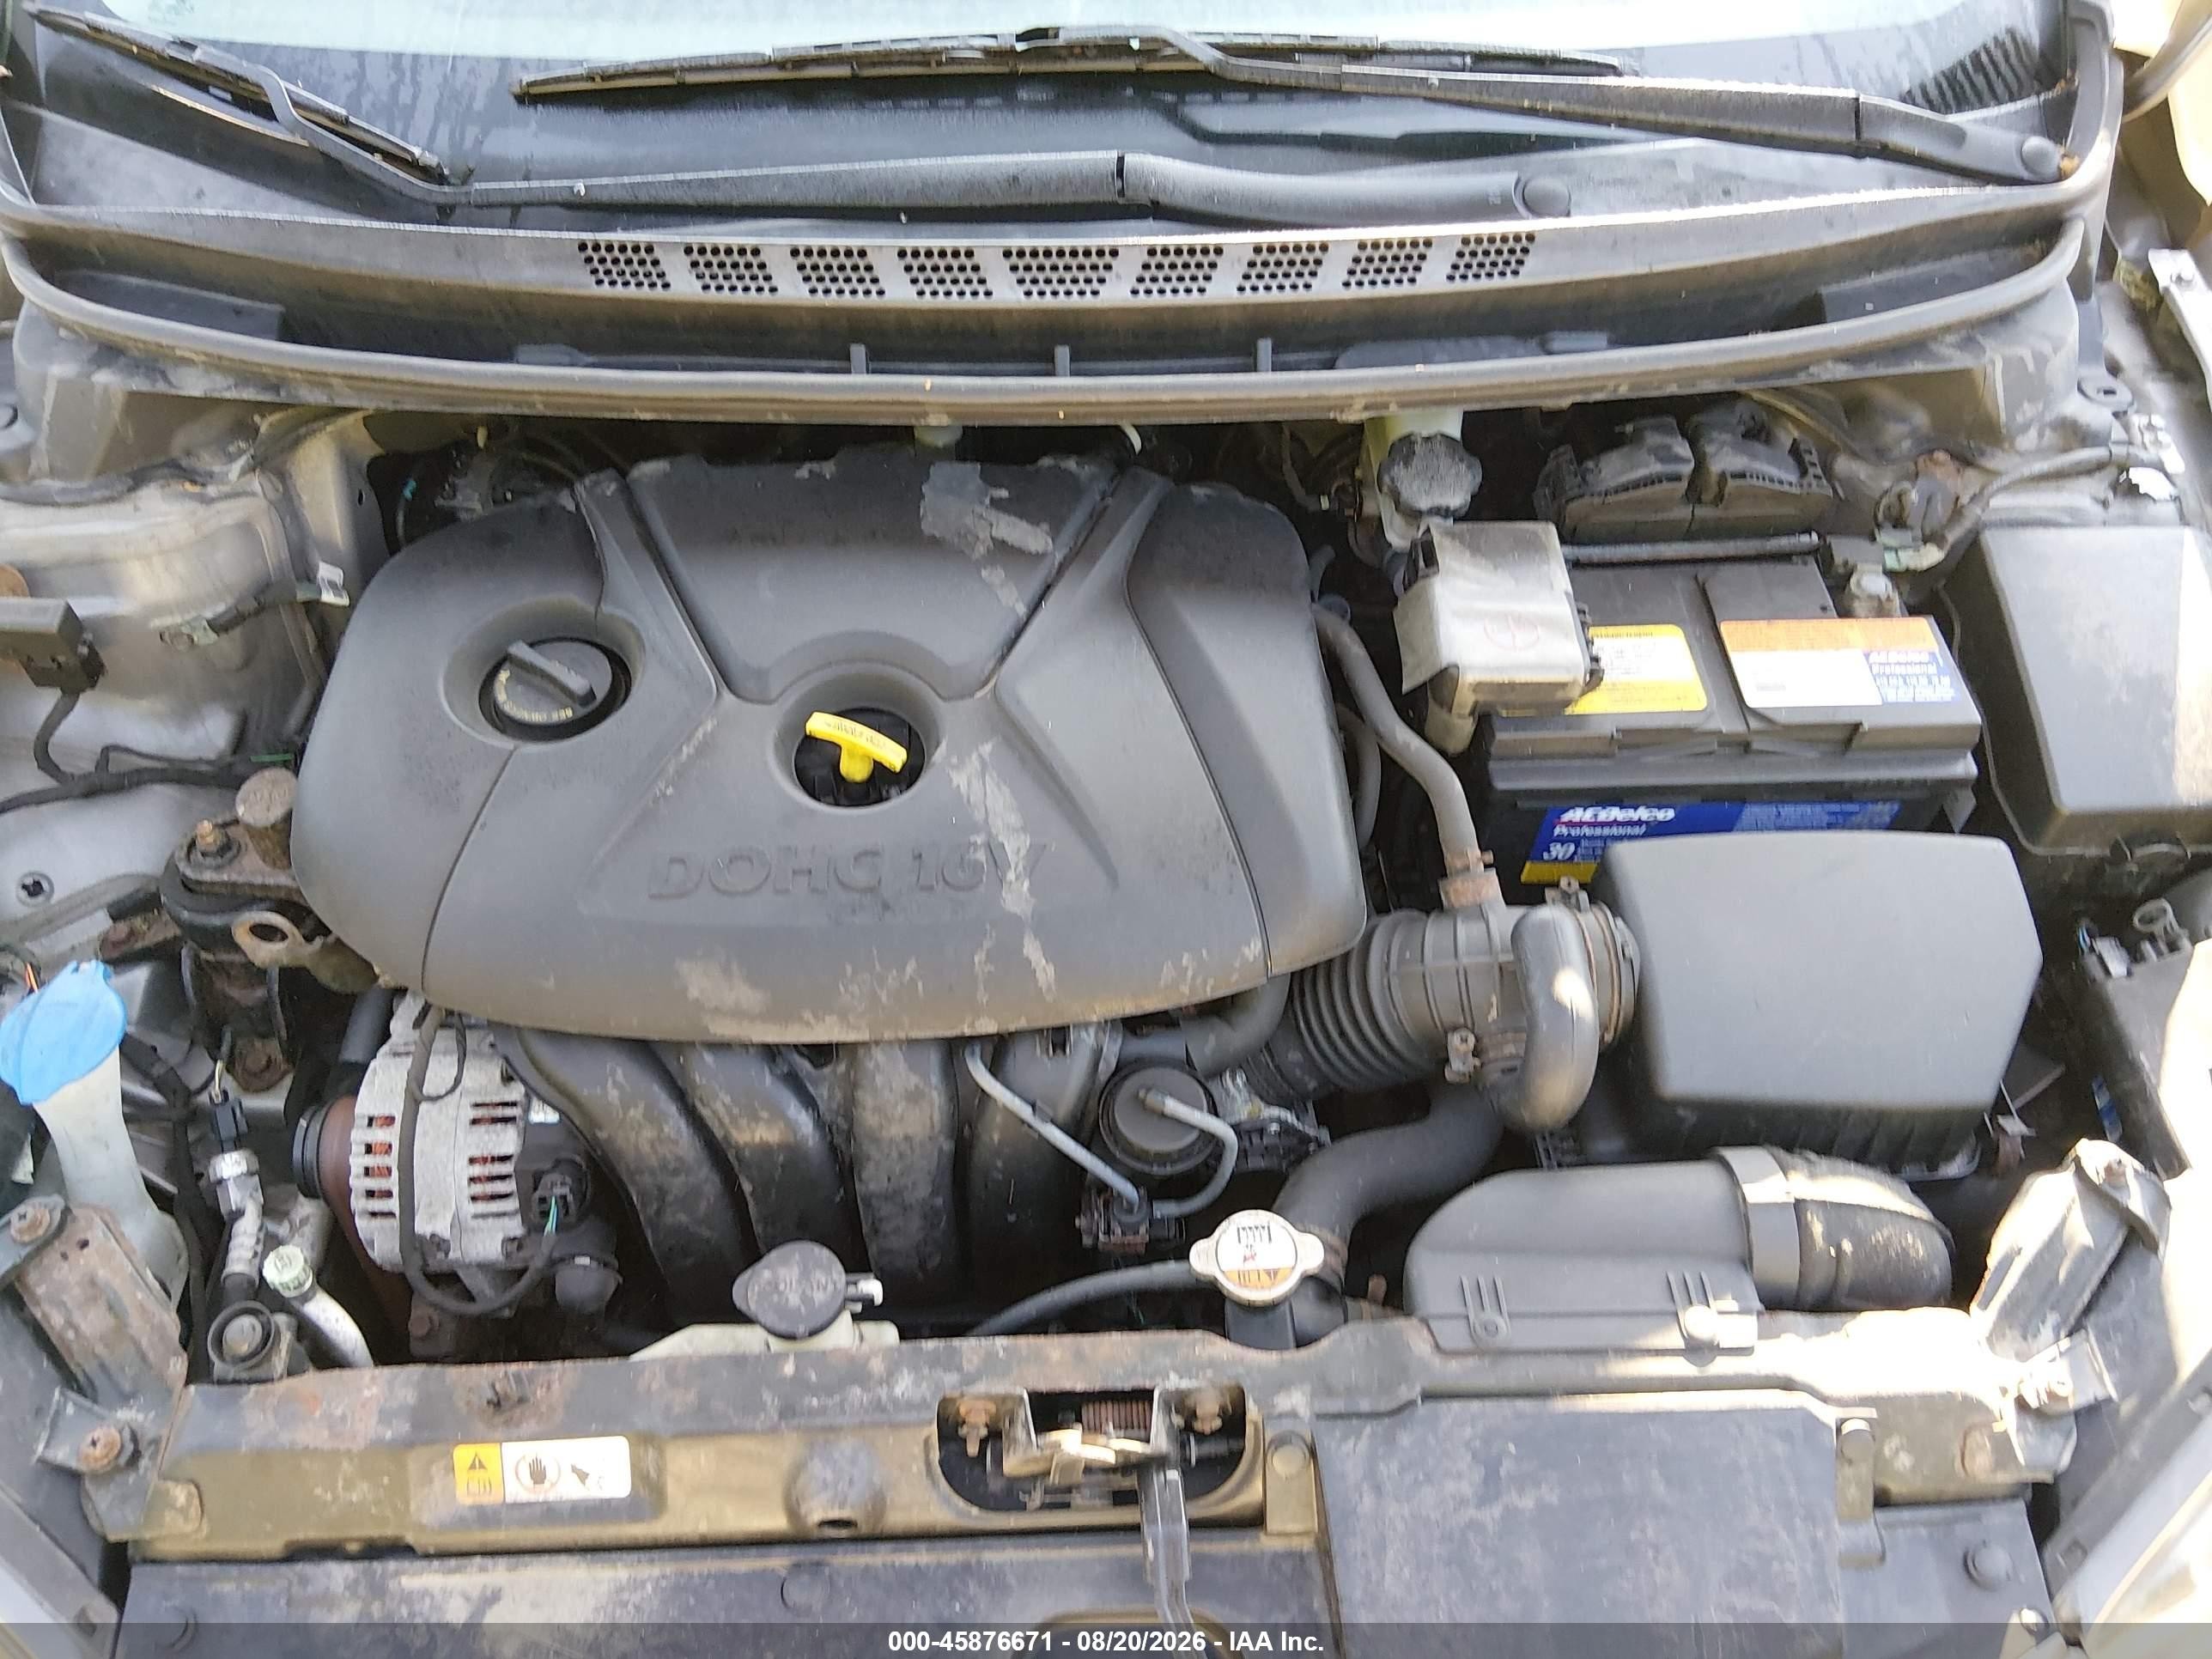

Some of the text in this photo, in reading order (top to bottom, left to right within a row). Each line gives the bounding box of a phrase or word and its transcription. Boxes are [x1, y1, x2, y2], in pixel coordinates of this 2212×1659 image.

[1559, 805, 1675, 822] ACDelco
[1553, 823, 1646, 837] Professional
[1542, 842, 1576, 861] 30
[647, 845, 883, 901] DOHC
